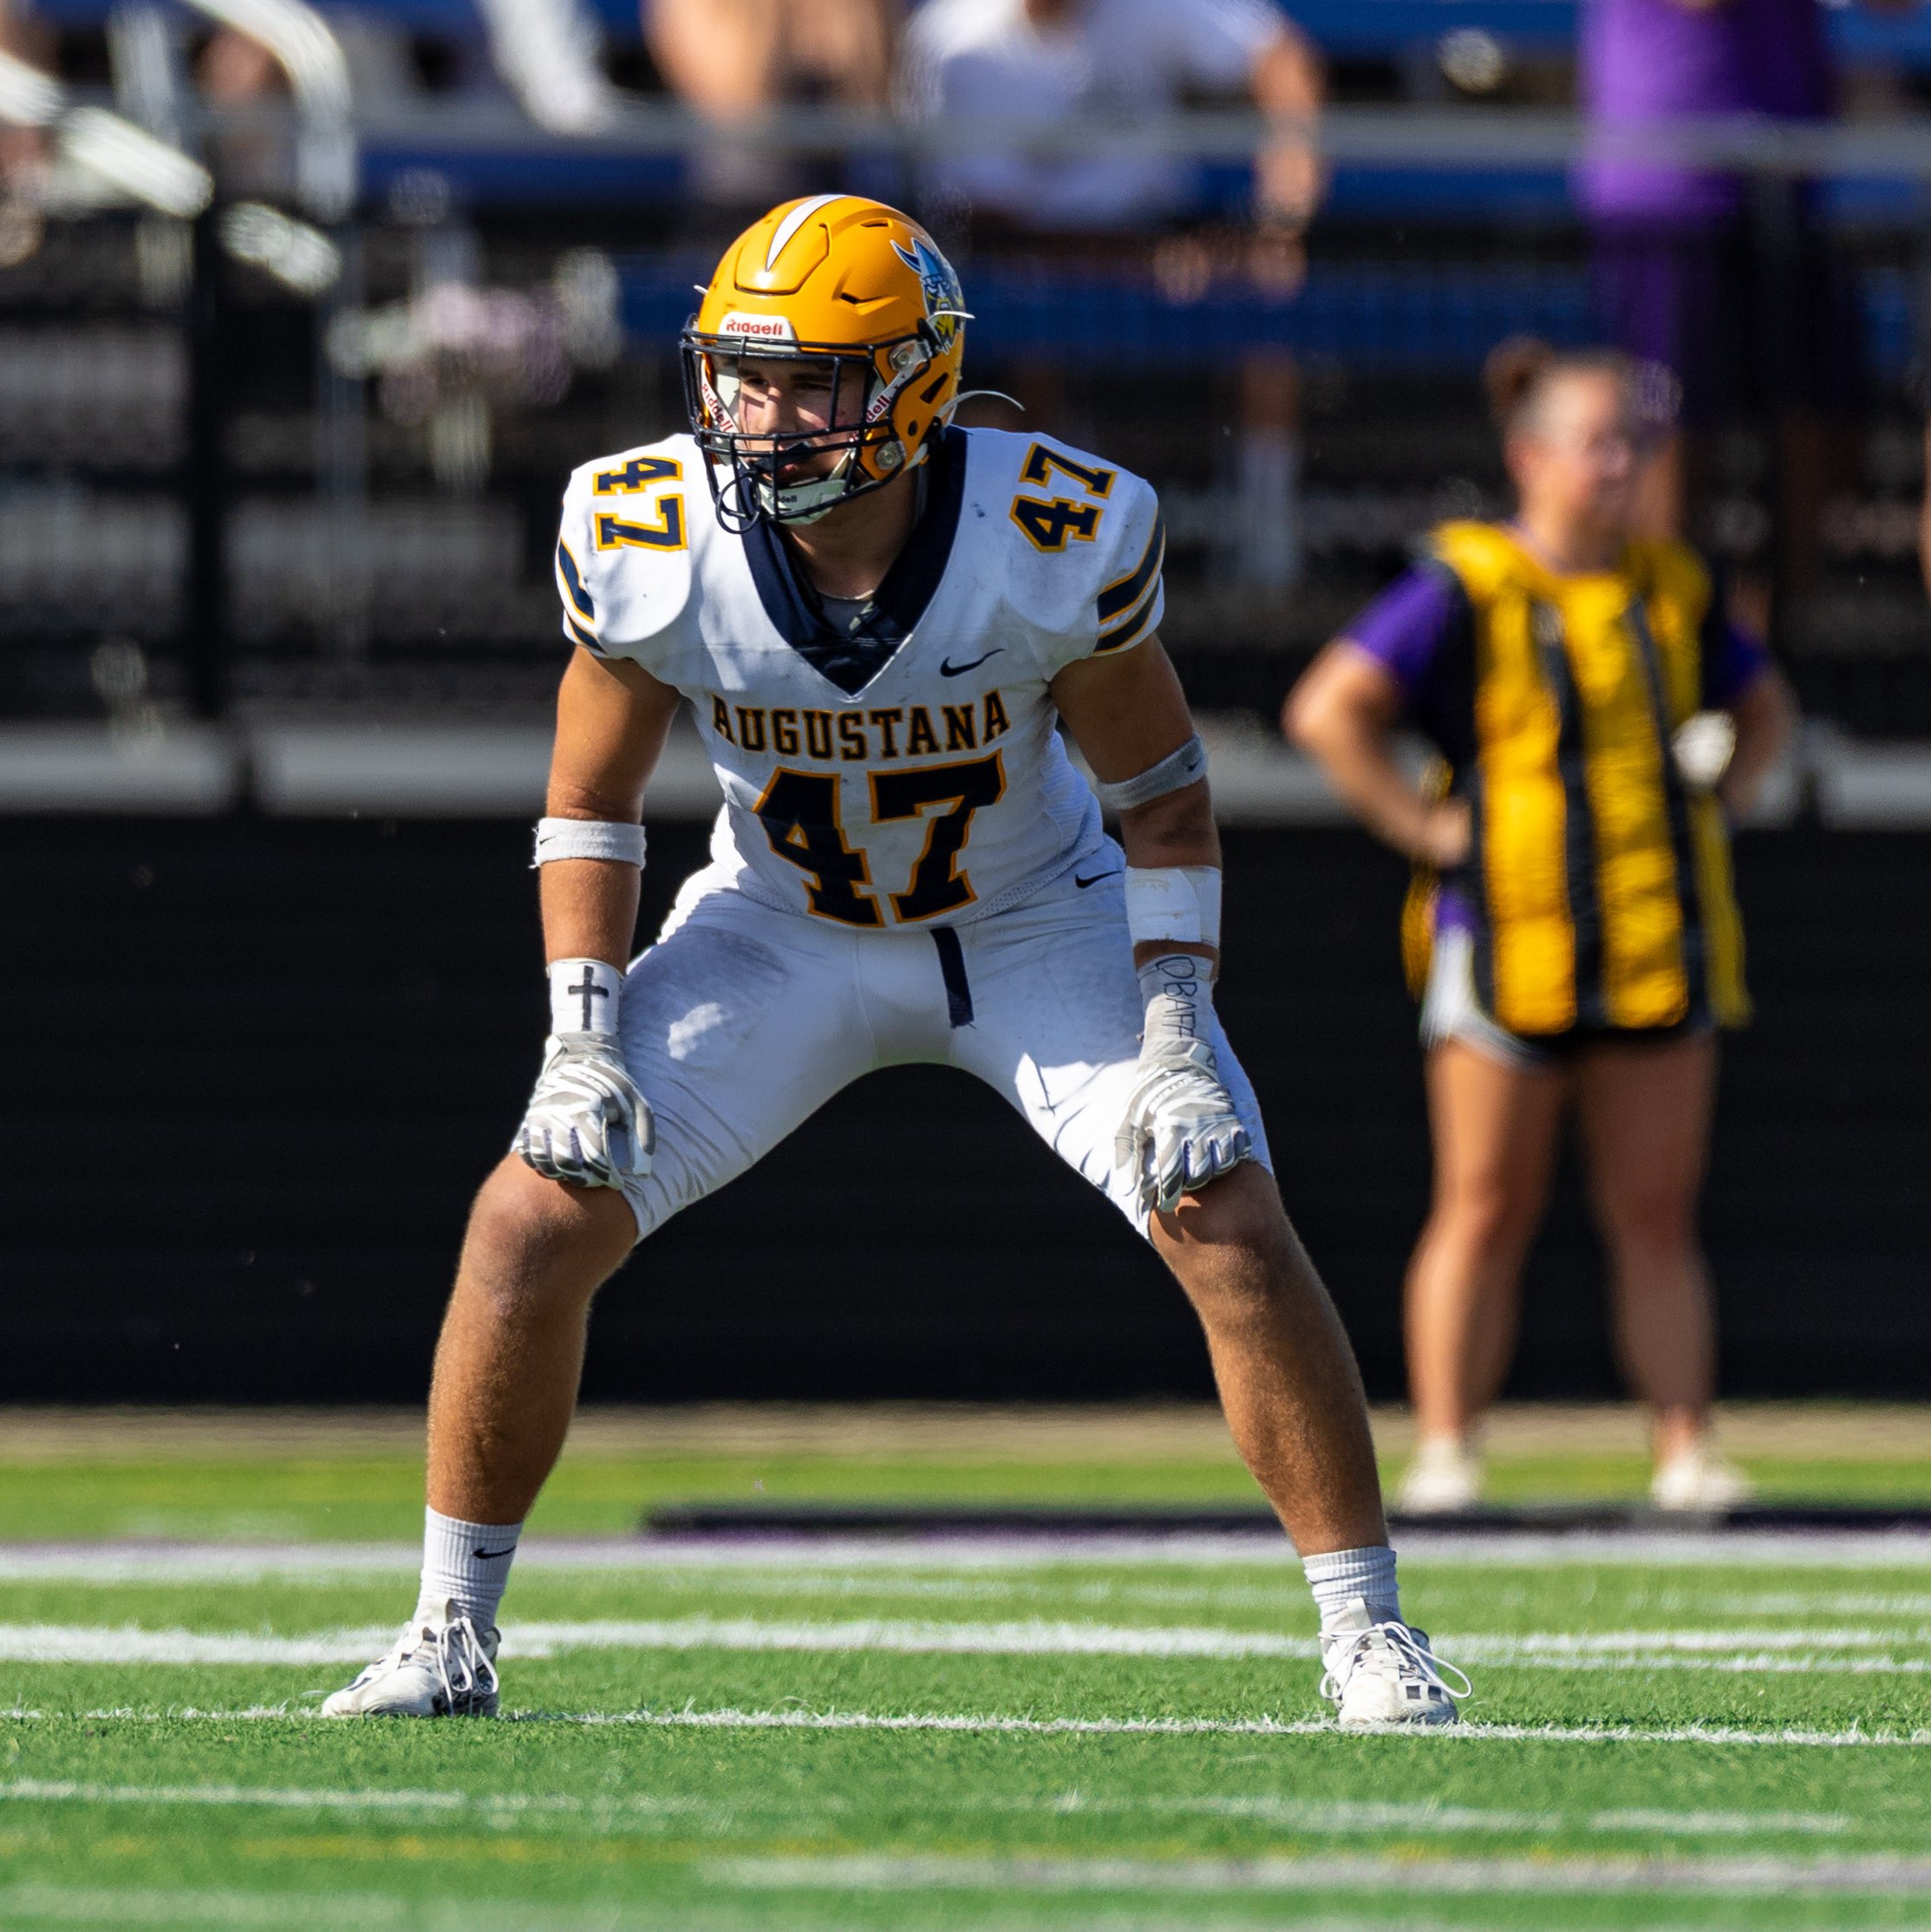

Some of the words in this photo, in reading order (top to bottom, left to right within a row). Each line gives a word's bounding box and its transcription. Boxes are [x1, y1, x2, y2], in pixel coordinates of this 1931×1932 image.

[726, 319, 783, 336] Riddell
[593, 455, 688, 552] 47
[1008, 441, 1118, 553] 47
[712, 689, 1011, 761] AUGUSTANA
[752, 749, 1008, 928] 47
